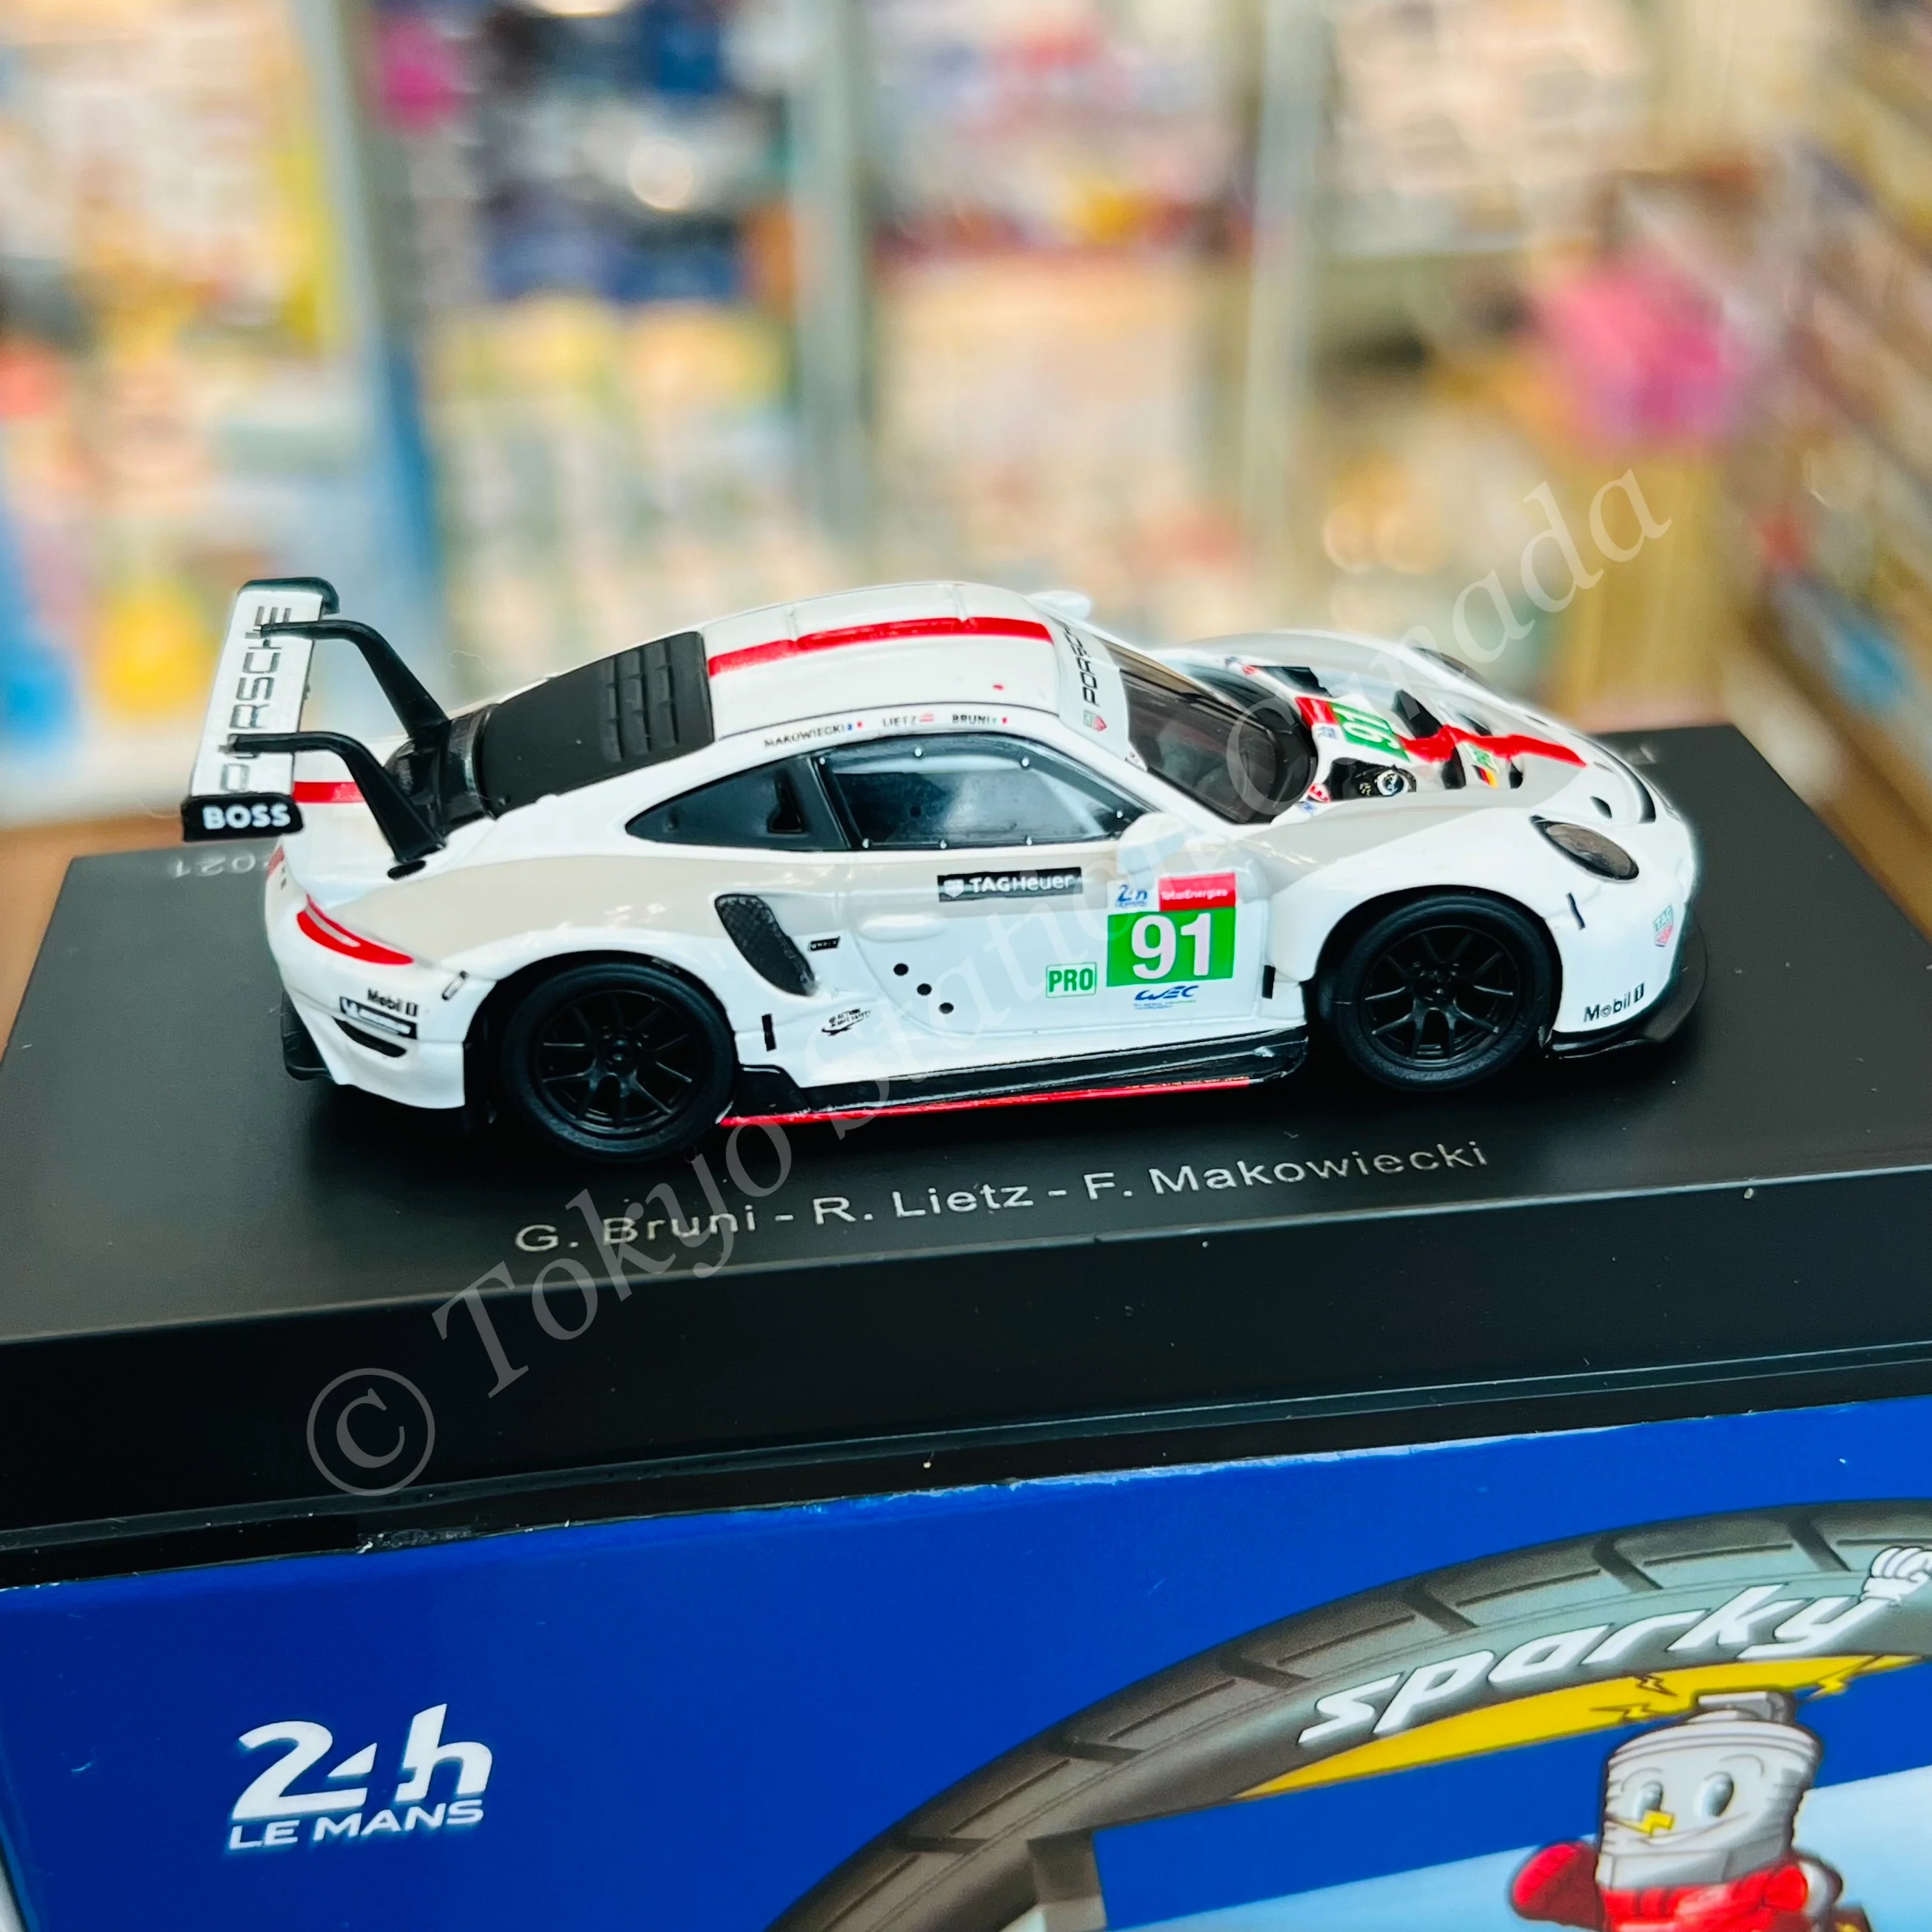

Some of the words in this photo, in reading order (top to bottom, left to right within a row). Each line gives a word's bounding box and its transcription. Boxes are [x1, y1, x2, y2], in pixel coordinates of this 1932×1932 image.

[201, 802, 291, 830] BOSS
[174, 854, 272, 878] 021
[1131, 912, 1211, 979] 91
[1048, 968, 1094, 993] PRO
[1584, 991, 1630, 1022] Mobil
[515, 1224, 579, 1252] G.
[602, 1205, 756, 1246] Bruni
[813, 1195, 873, 1225] R.
[893, 1183, 1033, 1218] Lietz
[1084, 1171, 1133, 1199] F.
[1149, 1141, 1489, 1195] Makowiecki
[1297, 1583, 1892, 1746] sparky
[231, 1703, 493, 1820] 24h
[229, 1820, 300, 1850] LE
[312, 1798, 484, 1841] MANS
